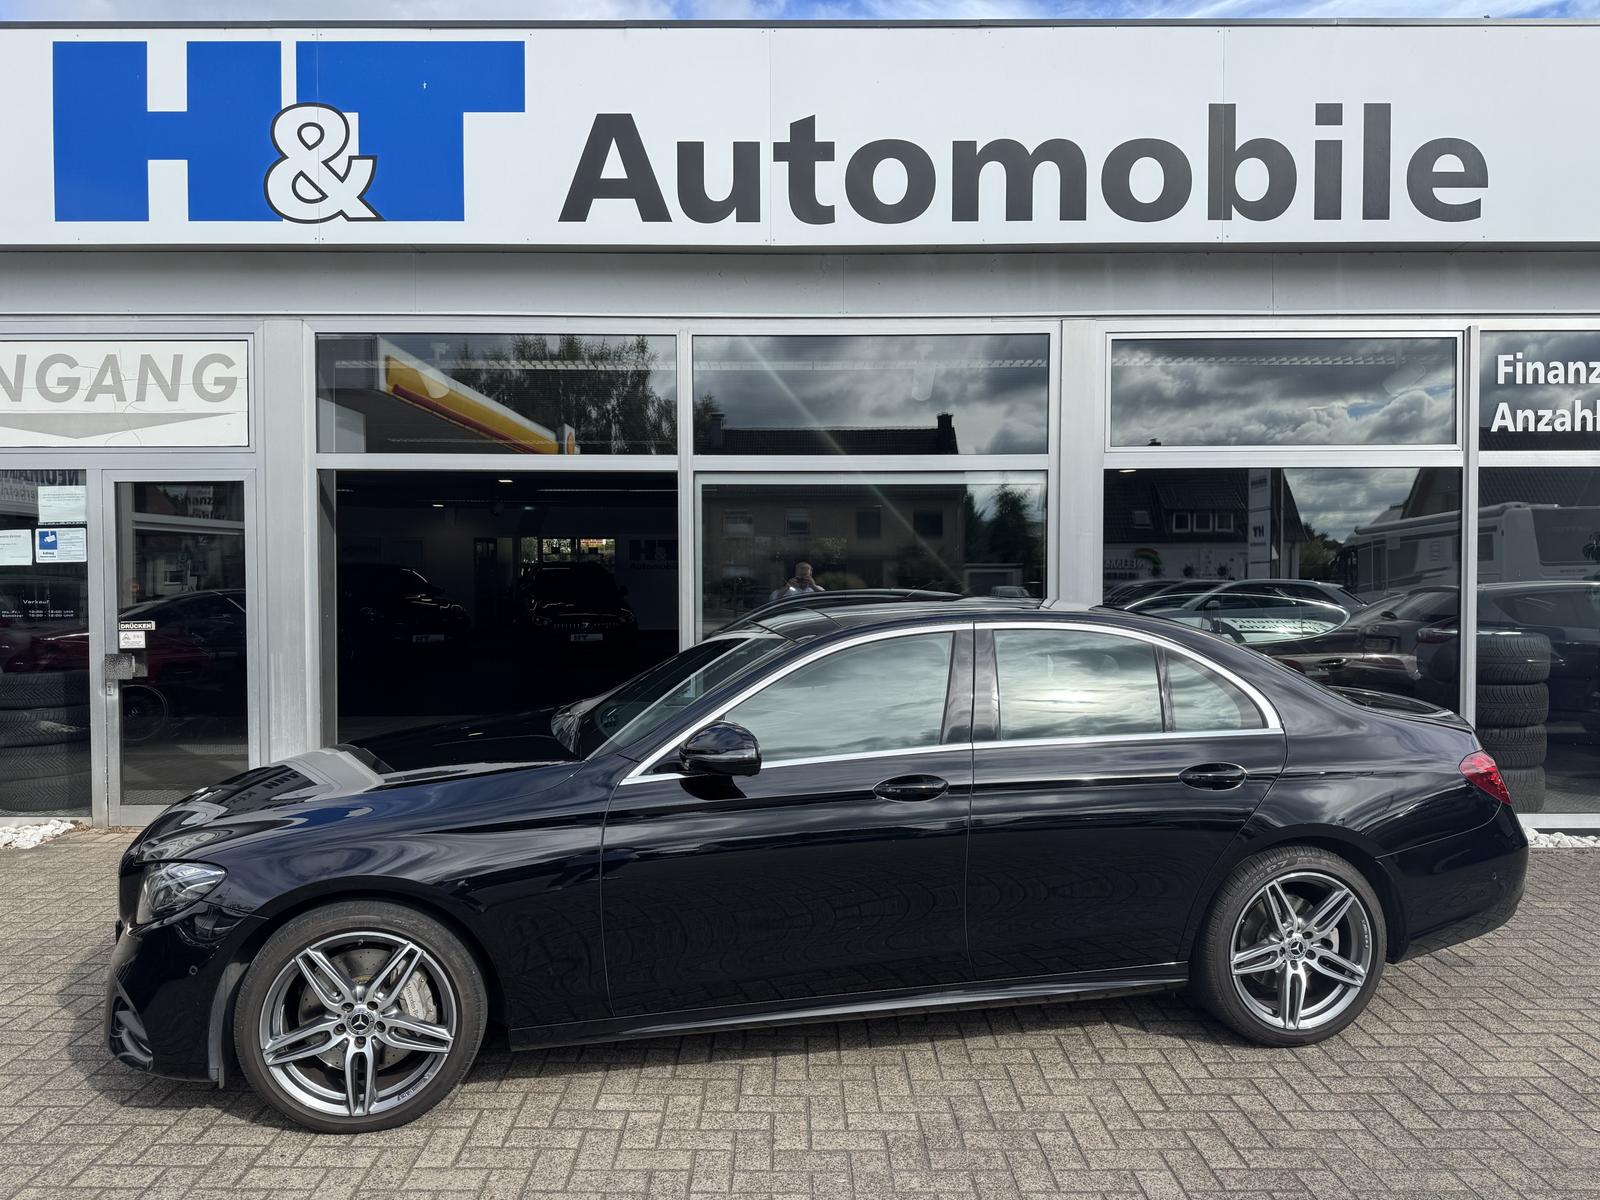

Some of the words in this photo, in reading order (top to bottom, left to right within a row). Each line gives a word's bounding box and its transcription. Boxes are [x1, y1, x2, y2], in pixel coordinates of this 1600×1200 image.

[52, 41, 525, 224] H&T
[558, 103, 1489, 225] Automobile
[1497, 352, 1600, 385] Finanz
